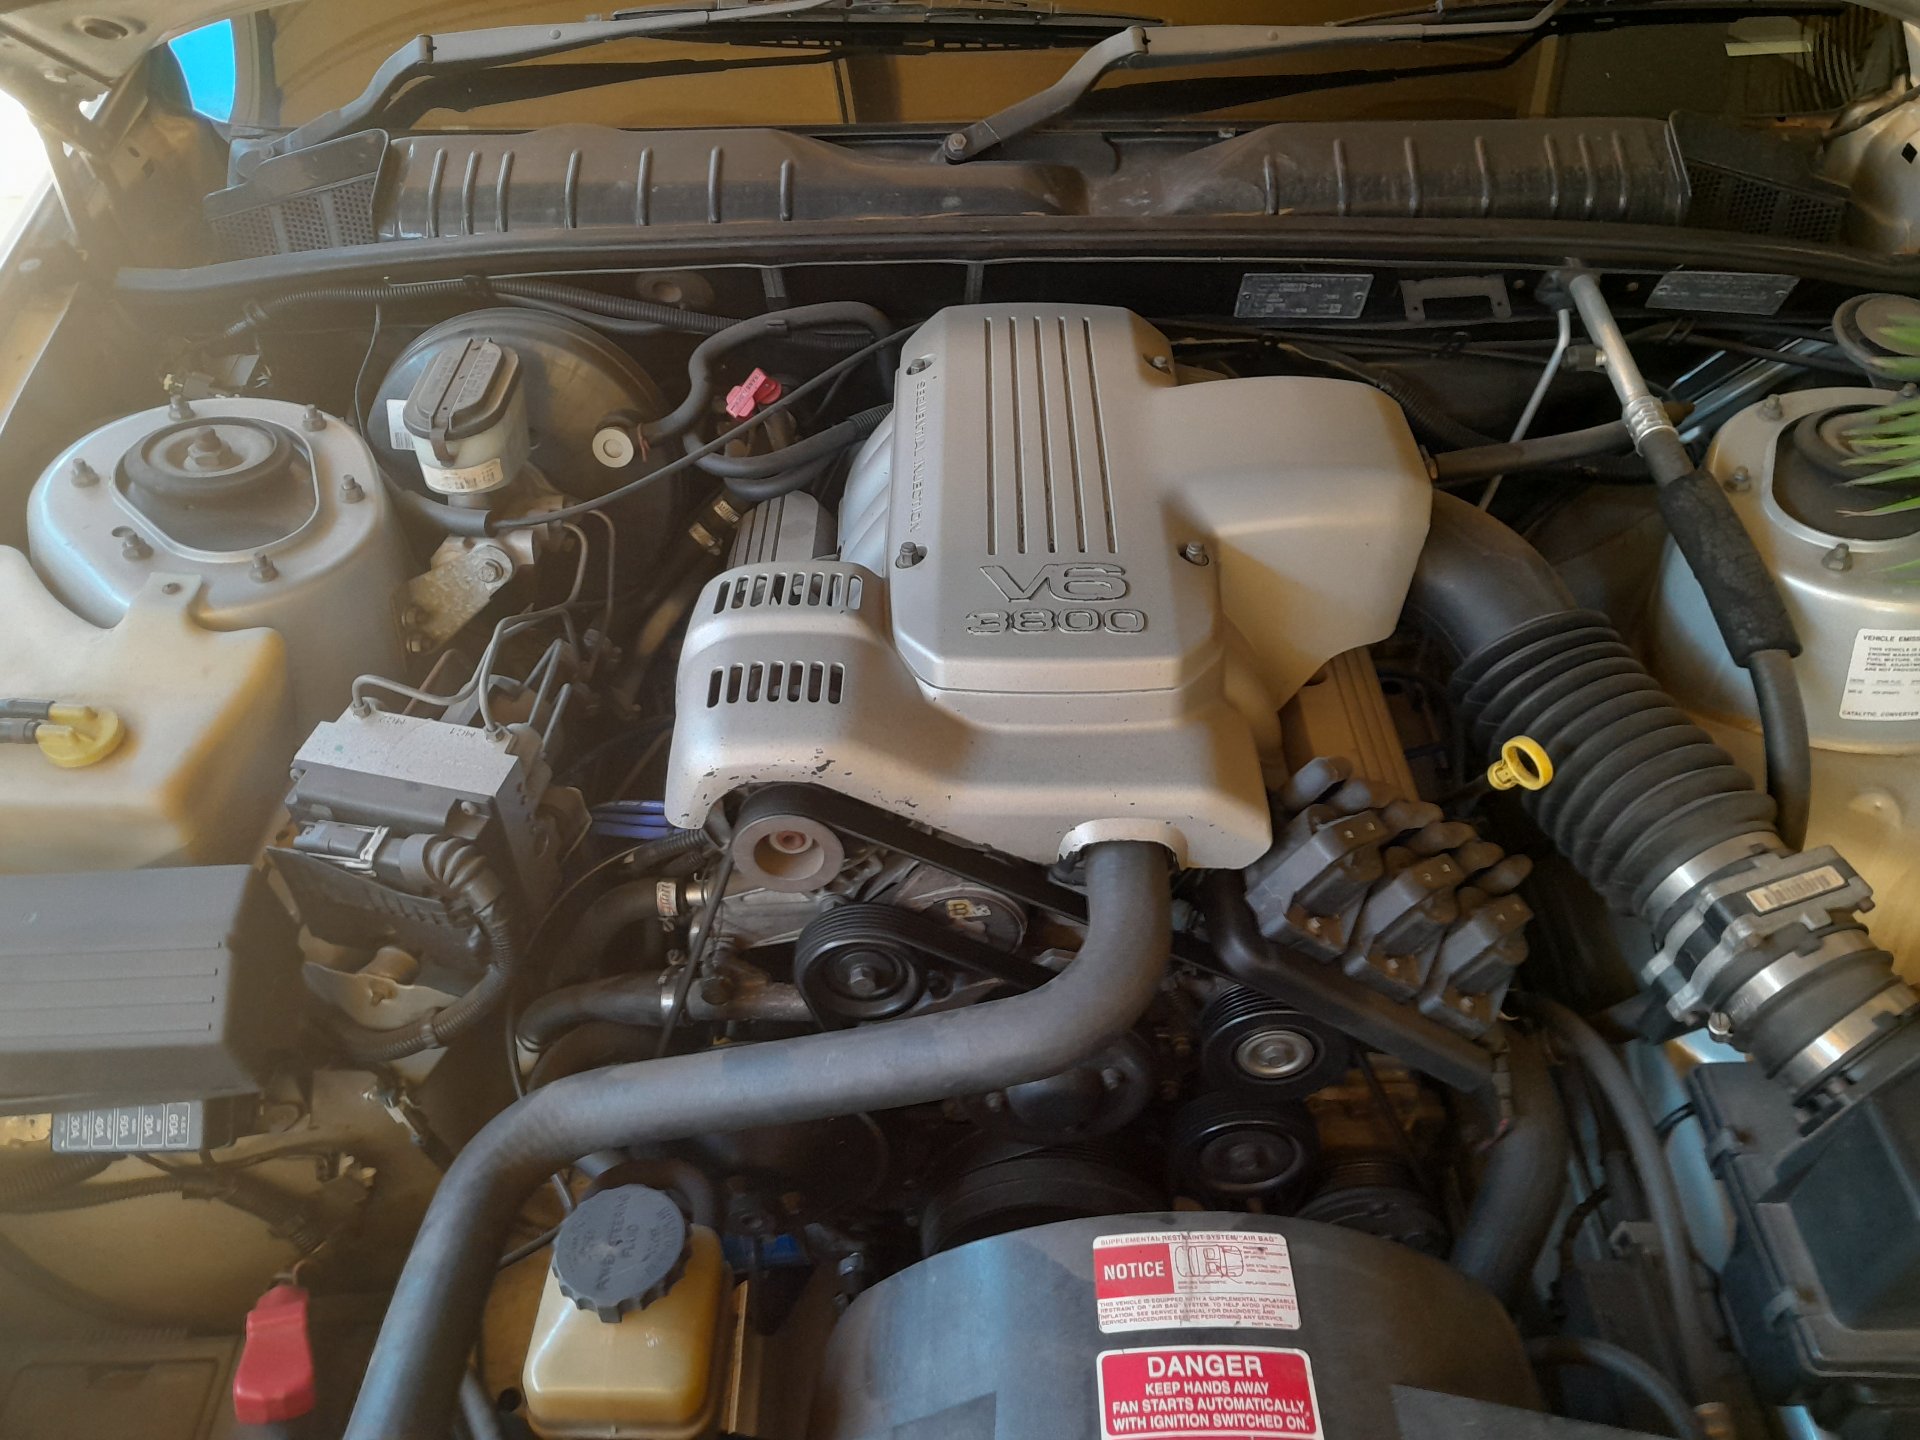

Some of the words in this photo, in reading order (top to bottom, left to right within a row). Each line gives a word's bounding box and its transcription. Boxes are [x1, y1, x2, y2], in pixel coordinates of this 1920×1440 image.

[913, 380, 927, 457] SEQUENTIAL
[909, 459, 926, 533] INJECTION
[979, 561, 1128, 603] V6
[965, 607, 1149, 635] 3800
[95, 1115, 104, 1139] 40A
[144, 1114, 154, 1137] 30A
[168, 1113, 179, 1137] 60A
[1101, 1235, 1160, 1246] SUPPLEMENTAL
[1162, 1234, 1204, 1242] RESTRAINT
[1103, 1260, 1166, 1281] NOTICE
[1258, 1297, 1296, 1305] INFLATABLE
[1262, 1303, 1297, 1311] UNWANTED
[1101, 1318, 1129, 1326] SERVICE
[1129, 1315, 1173, 1323] PROCEDURES
[1147, 1354, 1264, 1378] DANGER
[1145, 1382, 1180, 1396] KEEP
[1184, 1381, 1230, 1395] HANDS
[1233, 1381, 1269, 1395] AWAY
[1112, 1400, 1139, 1414] FAN
[1142, 1398, 1194, 1412] STARTS
[1197, 1397, 1305, 1413] AUTOMATICALLY
[1112, 1416, 1147, 1431] WITH
[1150, 1413, 1209, 1429] IGNITION
[1212, 1413, 1283, 1429] SWITCHED
[1286, 1415, 1310, 1431] ON.
